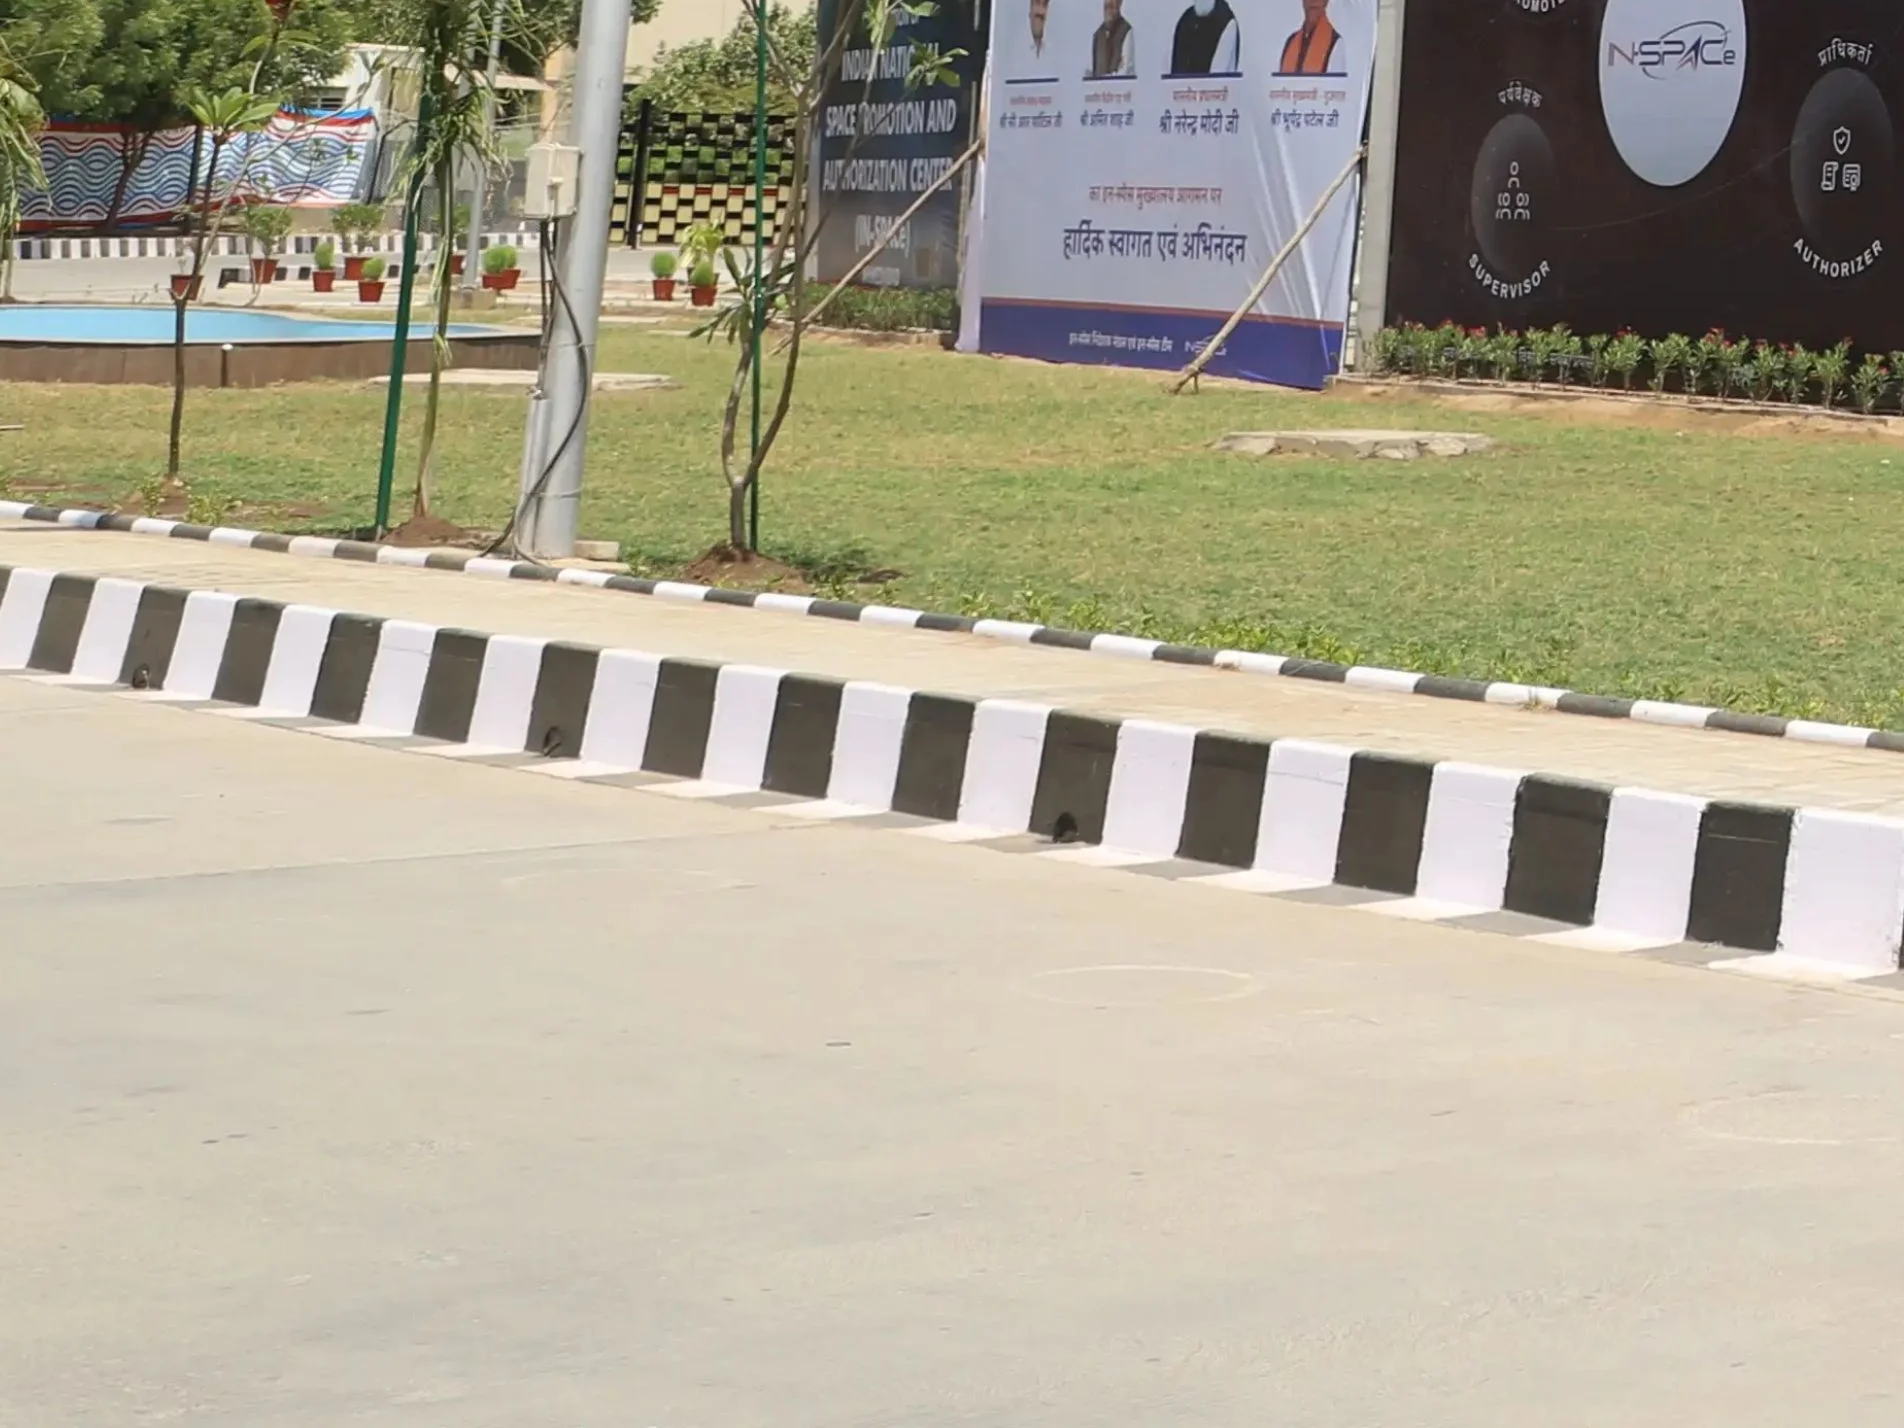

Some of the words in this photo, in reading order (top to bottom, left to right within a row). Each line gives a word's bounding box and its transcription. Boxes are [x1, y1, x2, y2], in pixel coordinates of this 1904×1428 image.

[826, 104, 856, 138] SPACE
[926, 98, 957, 133] AND
[1159, 108, 1172, 134] श्री
[1200, 108, 1223, 134] मोदी
[1225, 107, 1240, 134] जी
[1063, 219, 1106, 260] हार्दिक
[1108, 228, 1154, 259] स्वागत
[1156, 223, 1179, 262] एवं
[1182, 222, 1248, 266] अभिनंदन
[1793, 238, 1883, 277] AUTHORIZER
[1469, 253, 1551, 298] SUPERVISOR
